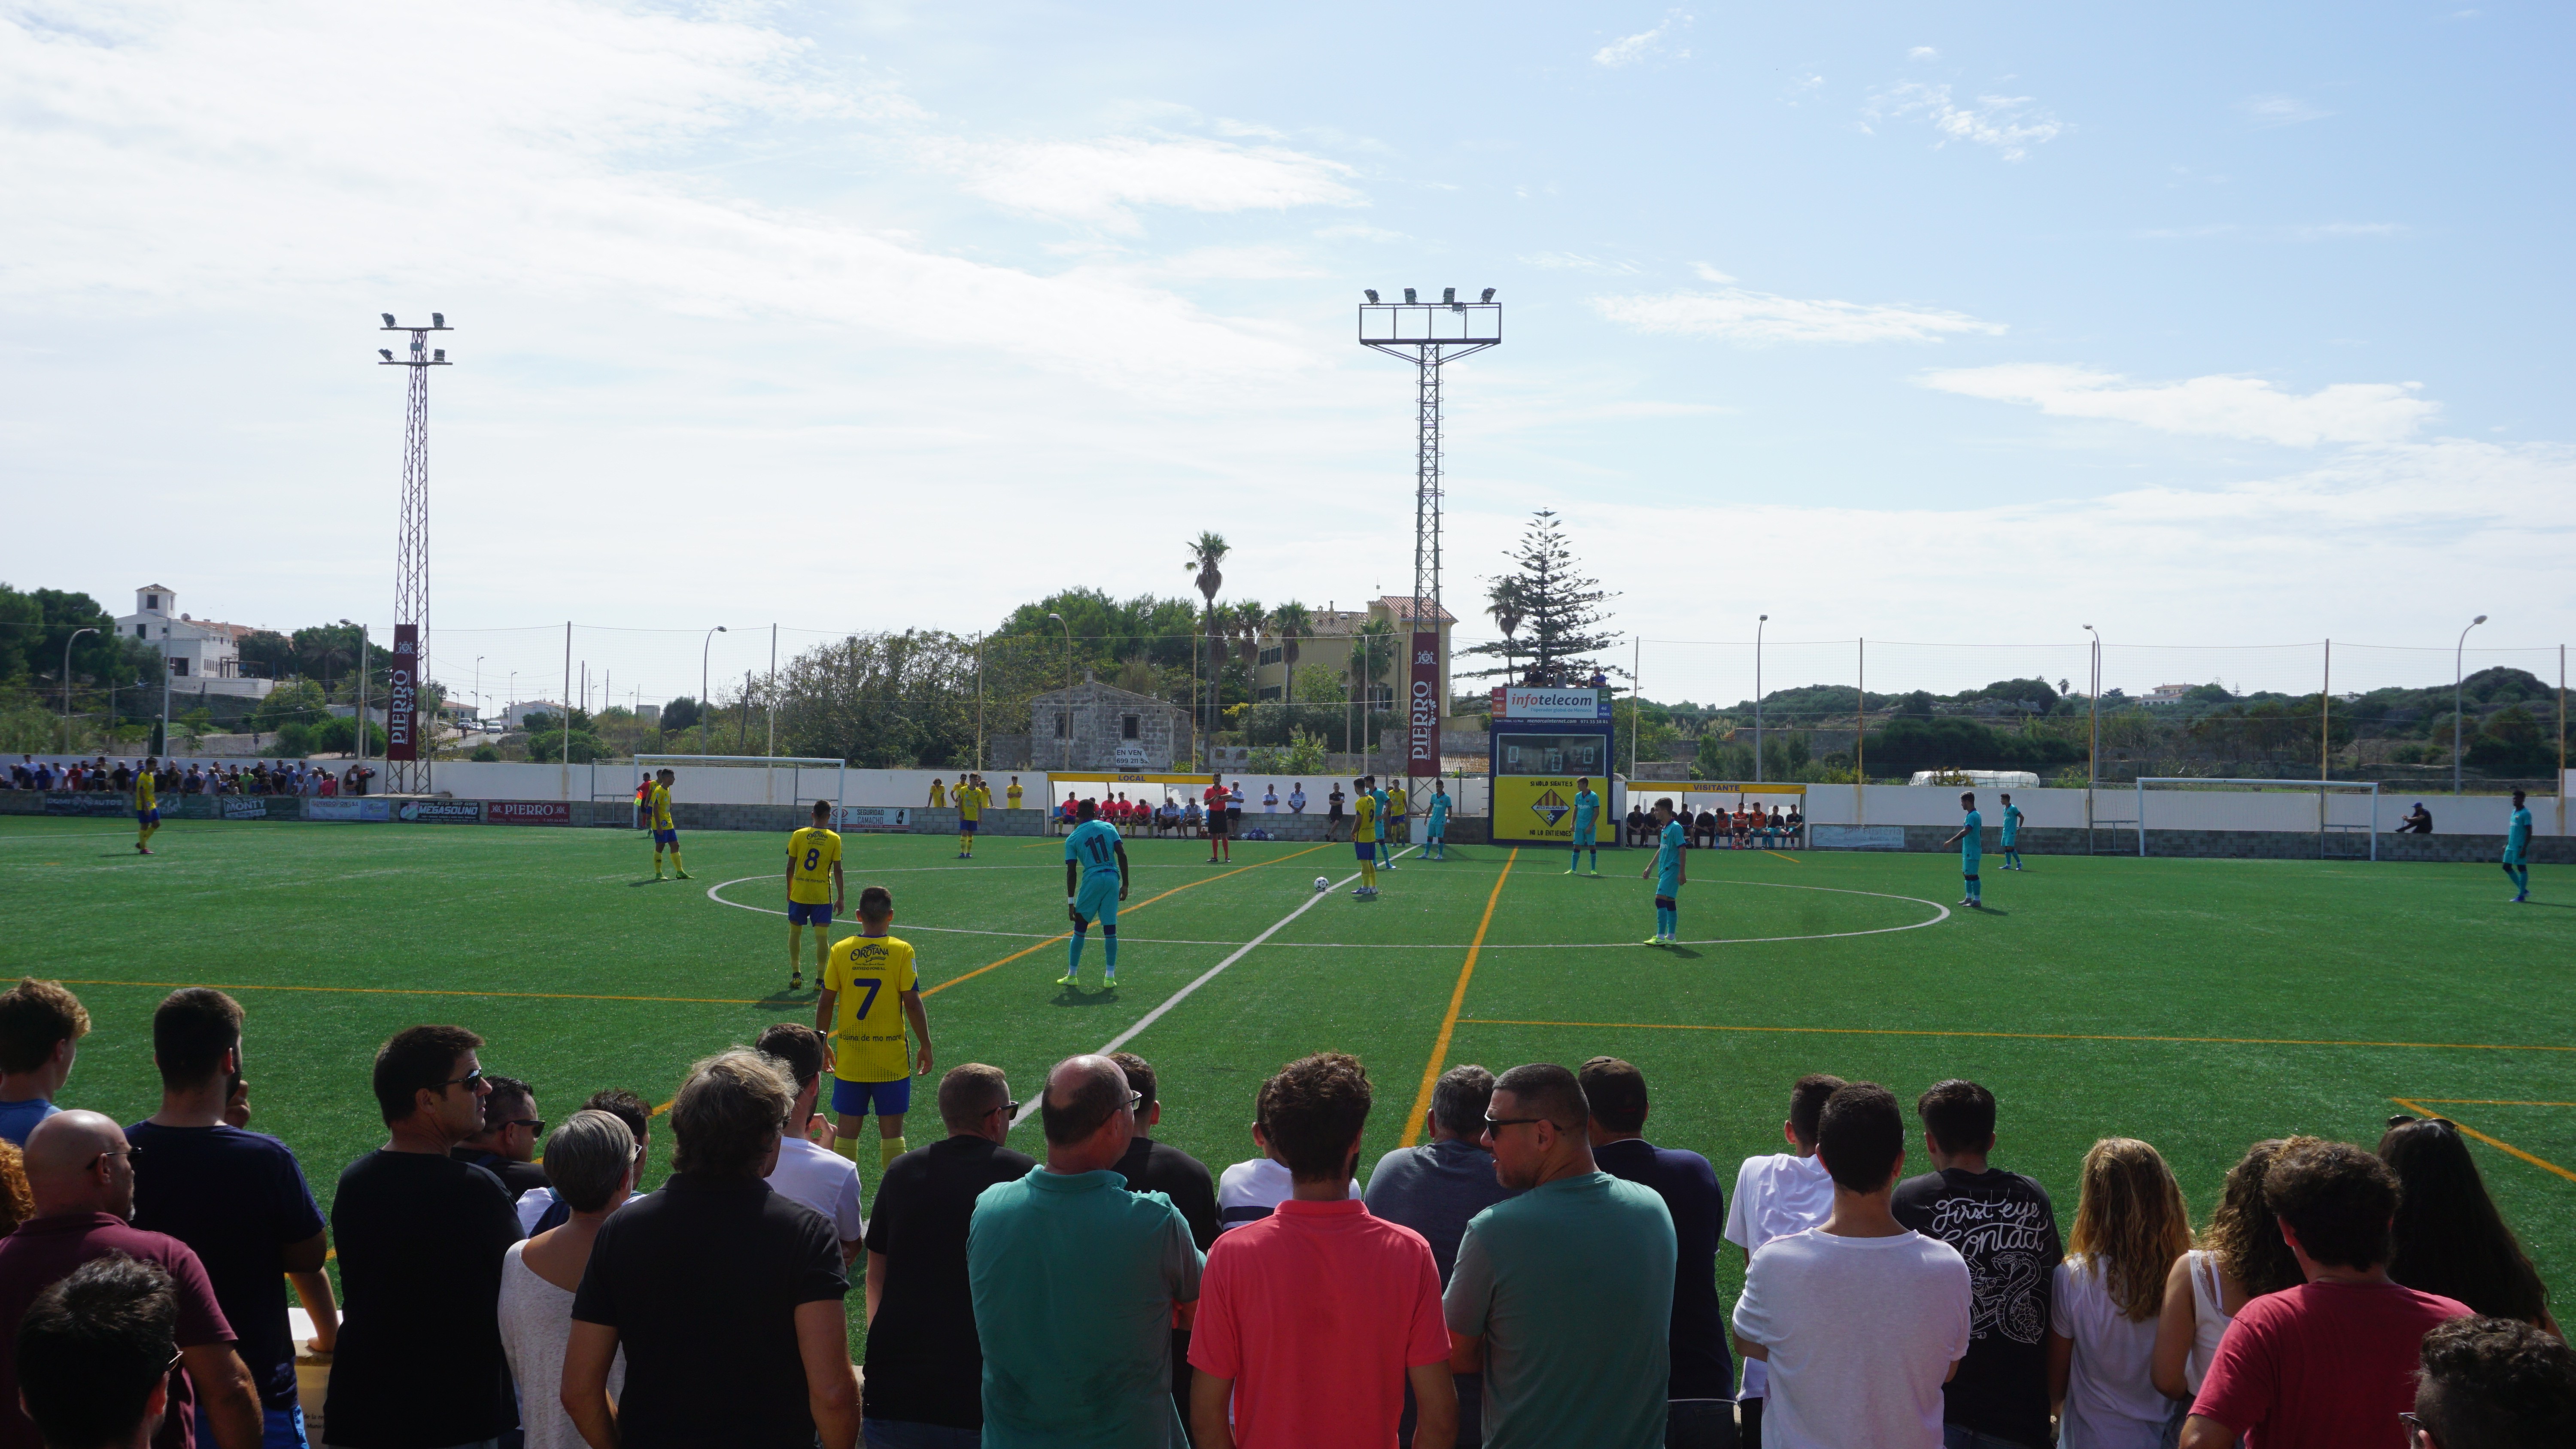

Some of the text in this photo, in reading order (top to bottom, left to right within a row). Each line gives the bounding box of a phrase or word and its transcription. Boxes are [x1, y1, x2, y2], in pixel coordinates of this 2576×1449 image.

[392, 670, 407, 744] PIERRO
[1512, 693, 1592, 708] infotelecom
[1413, 681, 1428, 760] PIERRO
[226, 800, 265, 812] MONTY
[419, 806, 478, 815] MEGASOUND
[505, 804, 553, 815] PIERRO
[1370, 809, 1374, 823] 9
[1084, 834, 1110, 864] 11
[804, 848, 820, 871] 8
[851, 947, 889, 961] OROTANA
[854, 978, 881, 1020] 7
[1932, 1198, 2039, 1232] First eye
